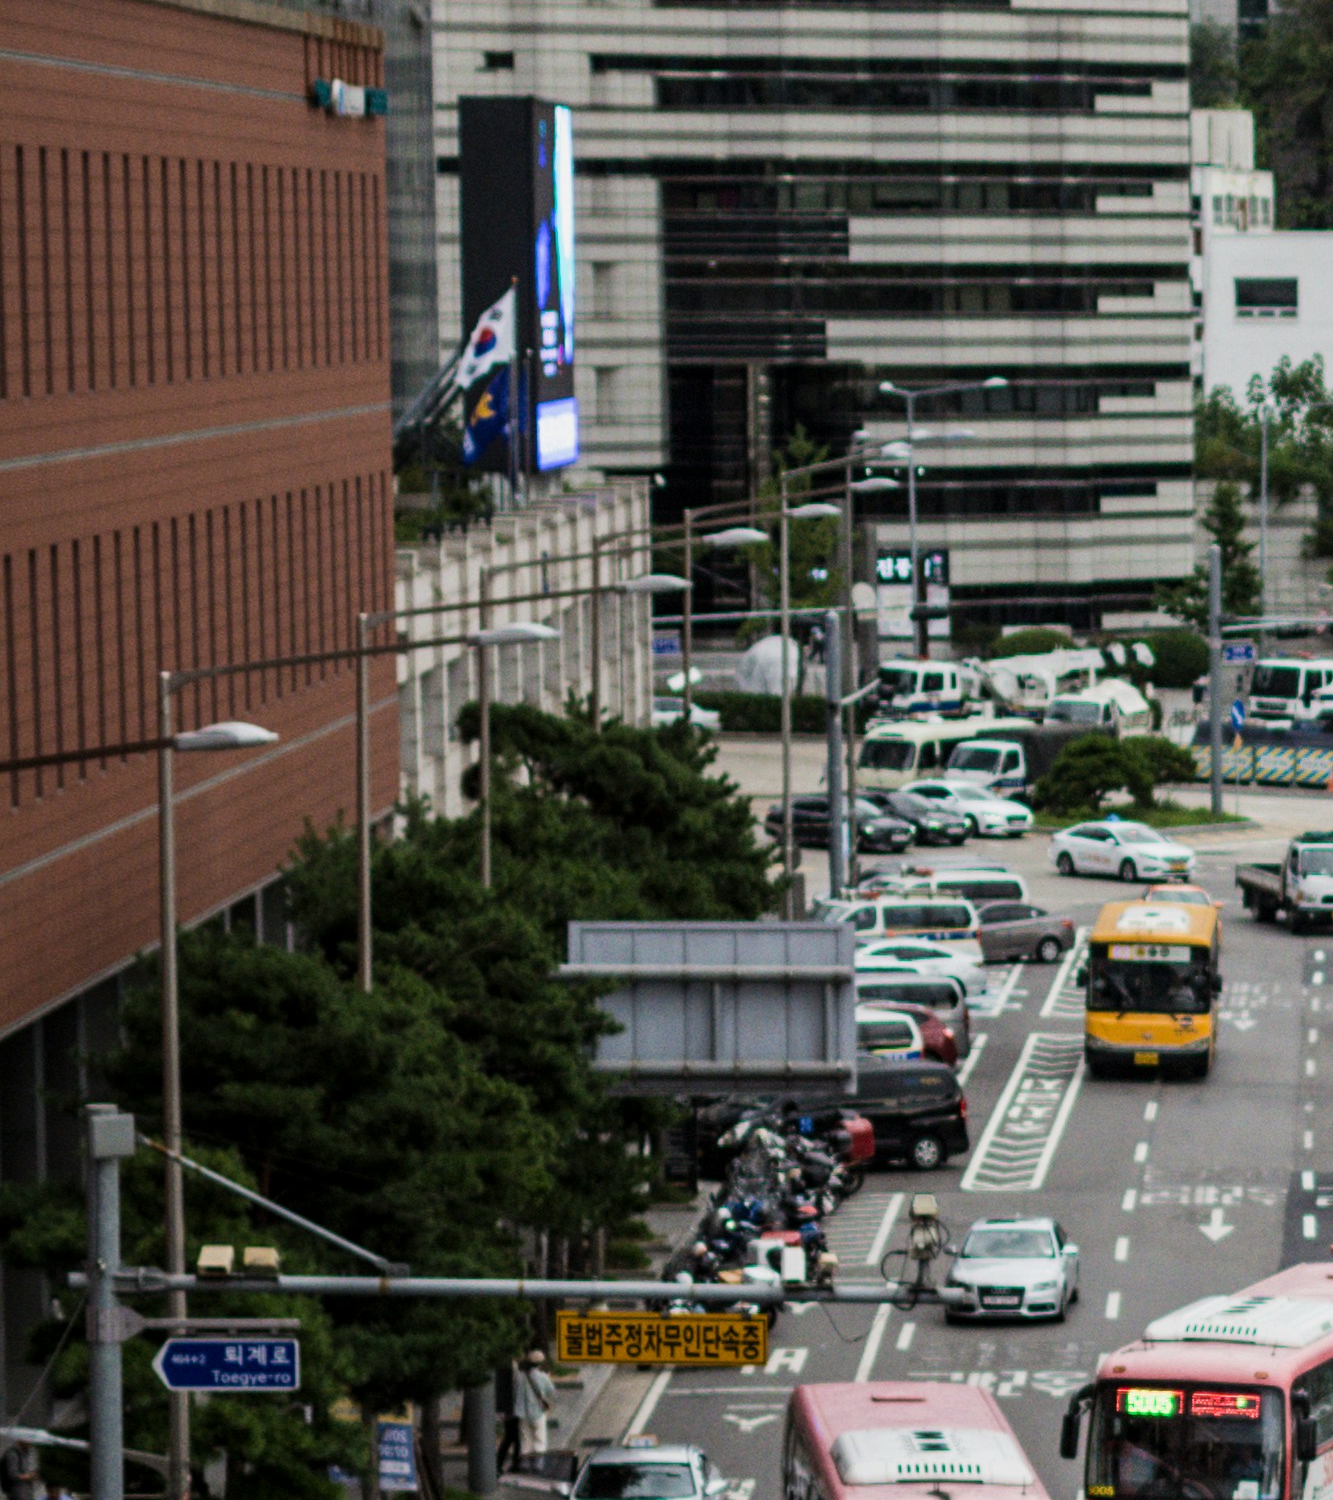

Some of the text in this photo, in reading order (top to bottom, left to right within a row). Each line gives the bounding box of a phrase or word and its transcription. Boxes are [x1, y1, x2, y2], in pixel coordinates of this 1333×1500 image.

[564, 1323, 762, 1361] 불법주정차무인단속중
[223, 1344, 289, 1366] 퇴계로
[211, 1369, 290, 1387] Toegye-ro
